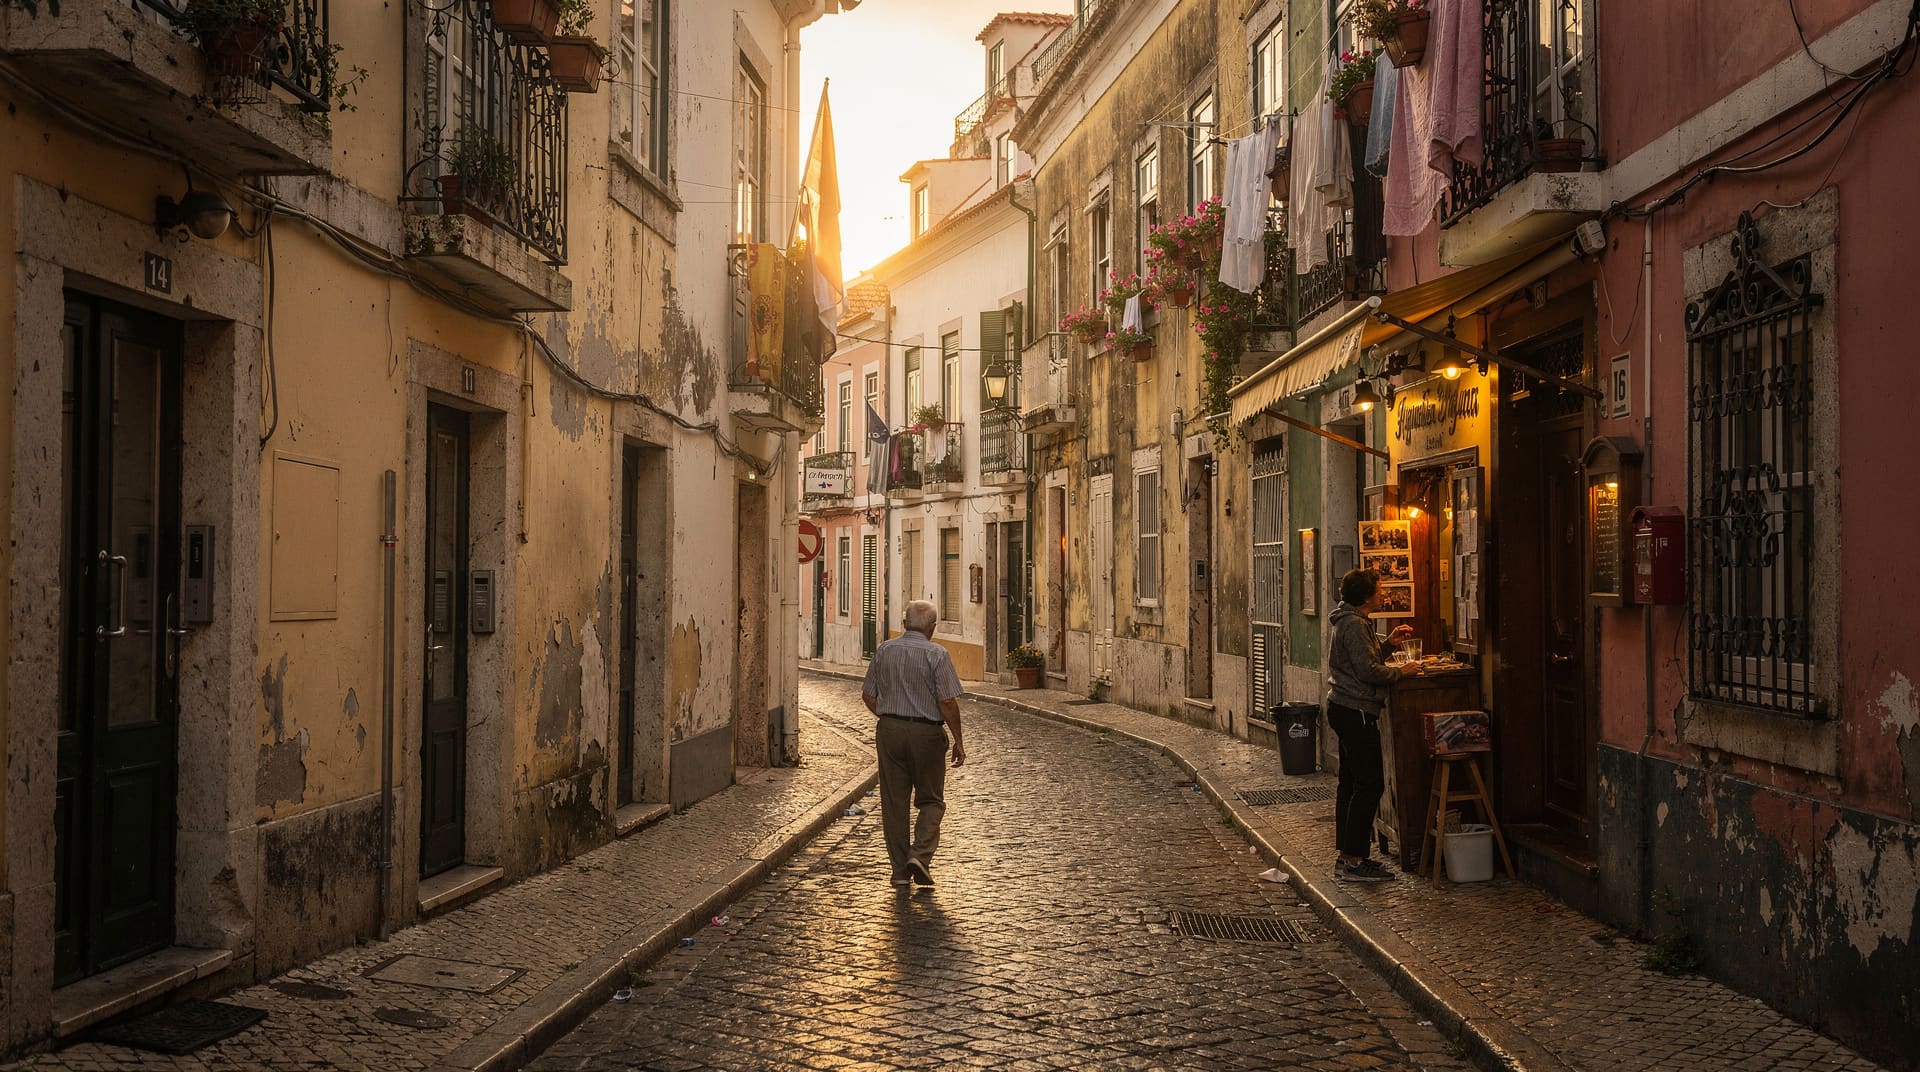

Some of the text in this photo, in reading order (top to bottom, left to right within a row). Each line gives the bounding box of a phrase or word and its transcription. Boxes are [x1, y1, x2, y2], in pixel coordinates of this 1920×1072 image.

[150, 256, 168, 289] 14
[465, 368, 473, 391] 11
[1613, 369, 1627, 402] 16
